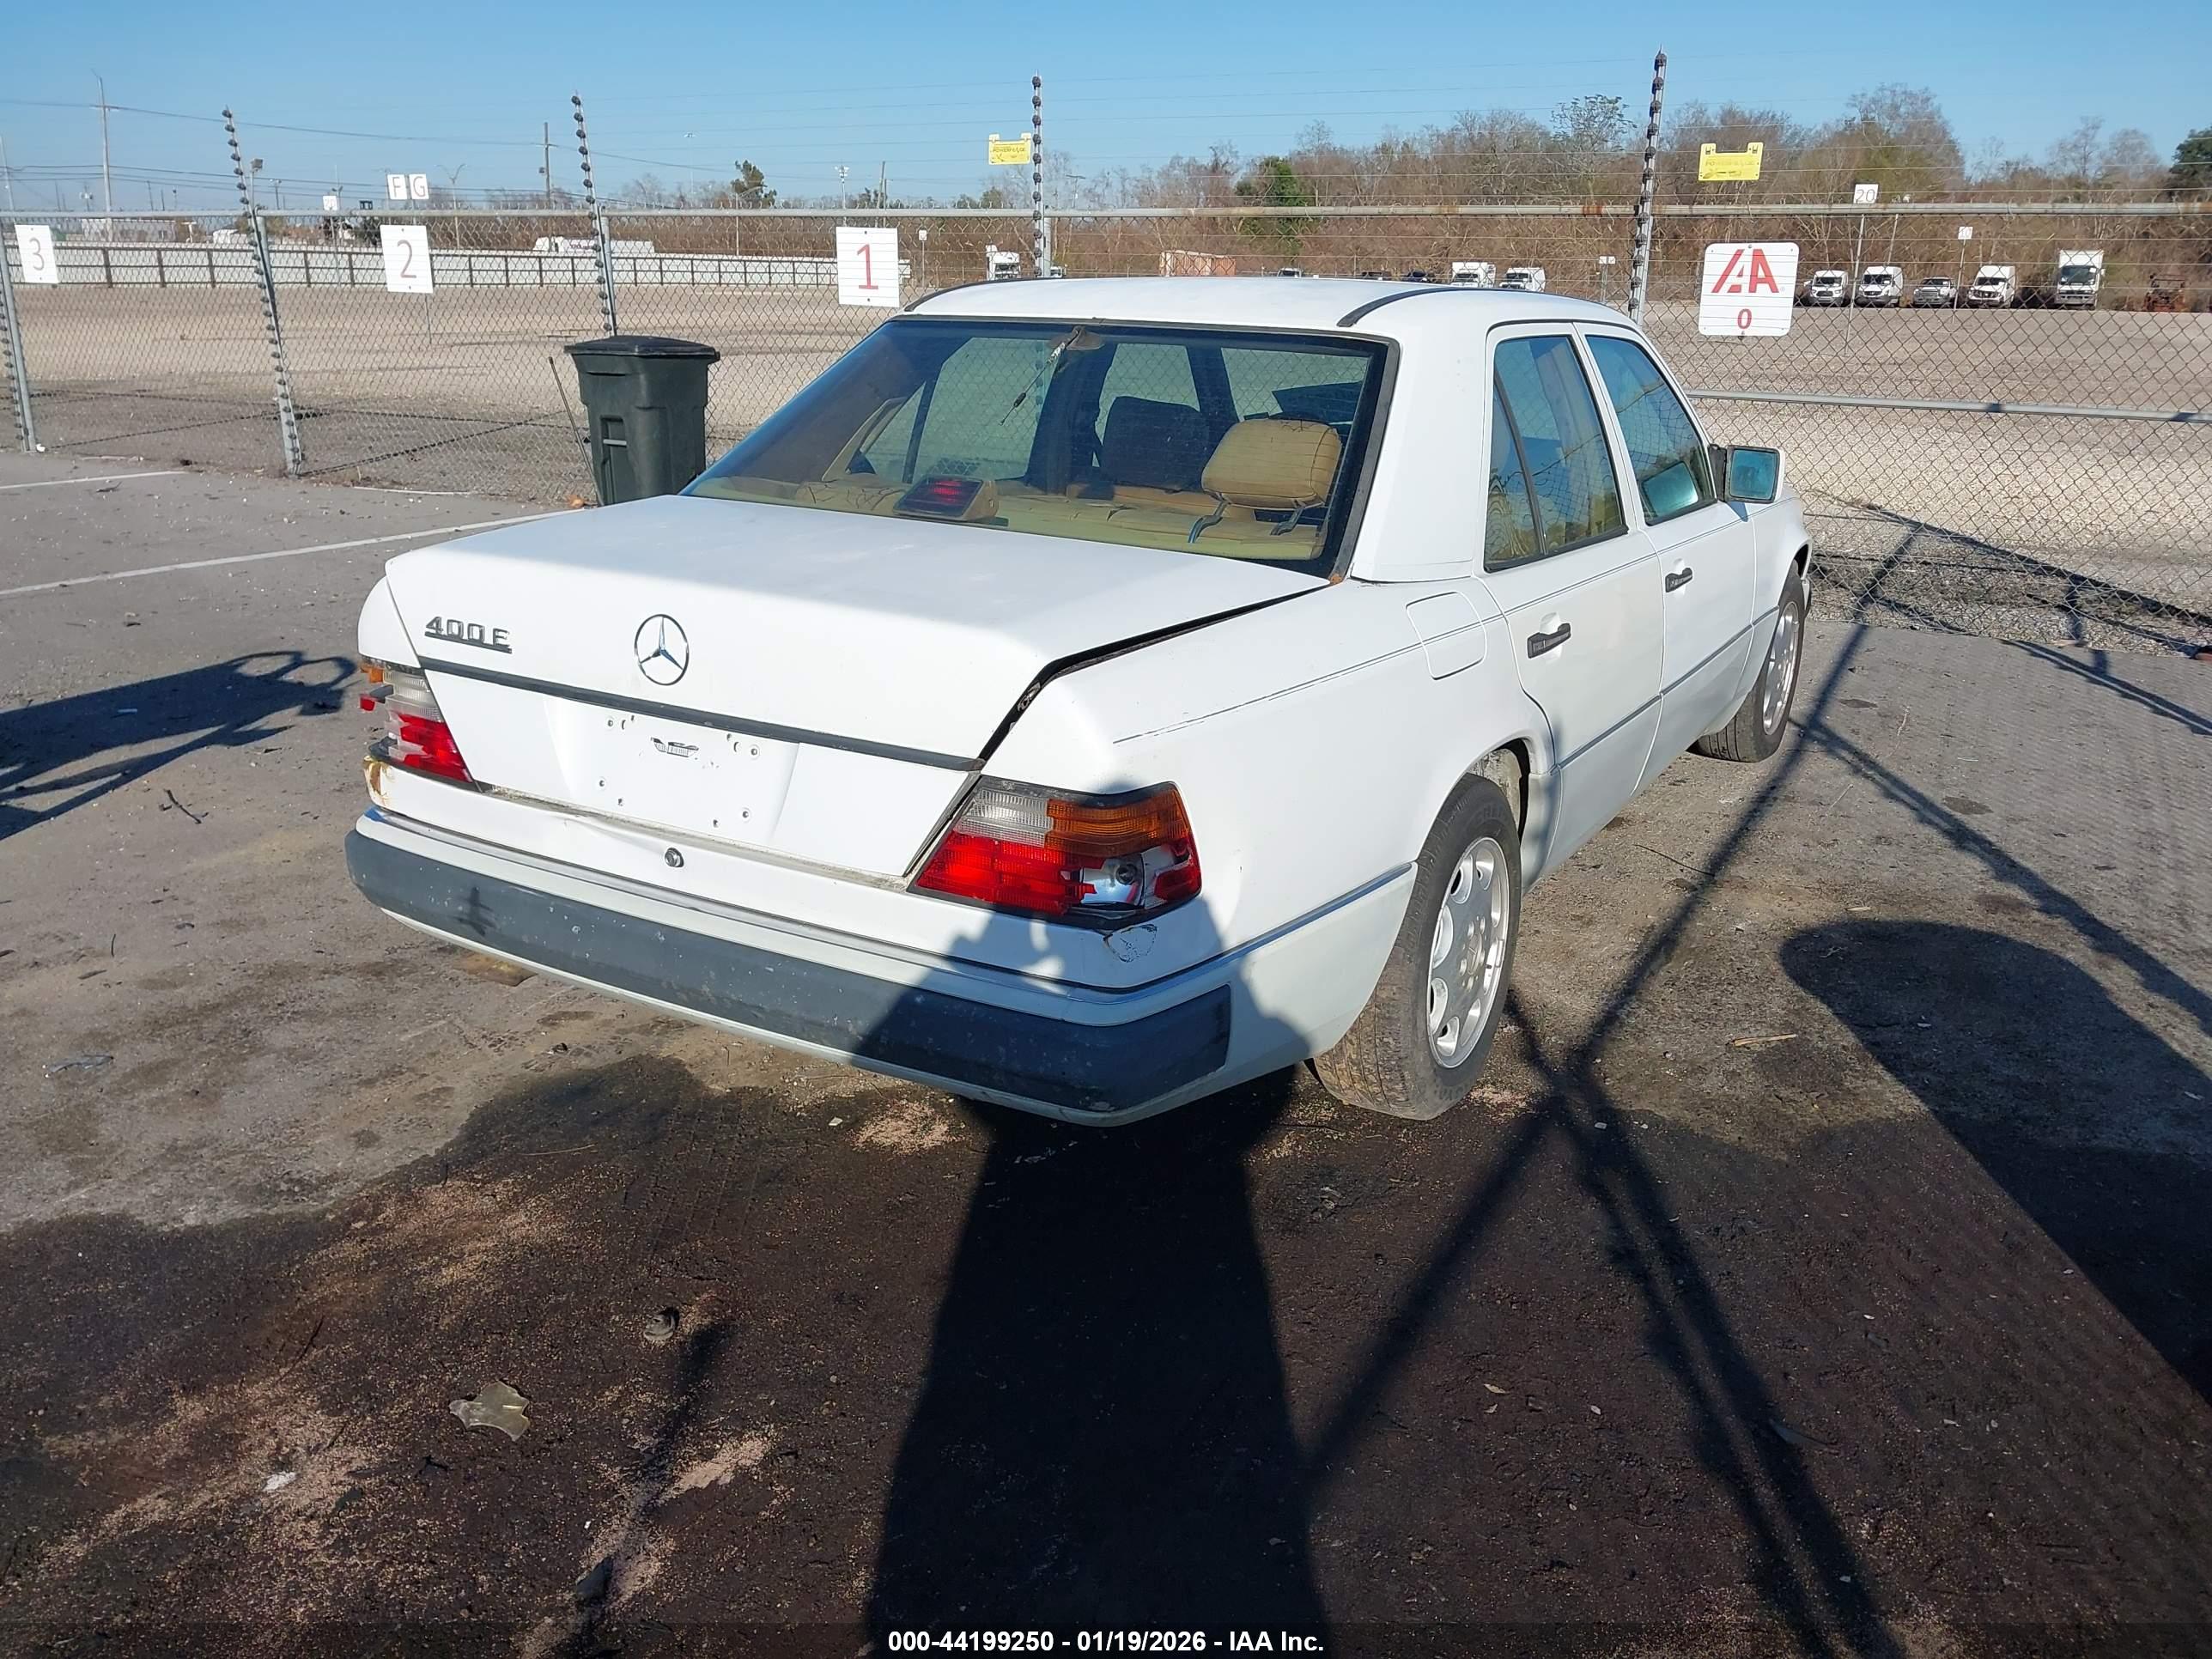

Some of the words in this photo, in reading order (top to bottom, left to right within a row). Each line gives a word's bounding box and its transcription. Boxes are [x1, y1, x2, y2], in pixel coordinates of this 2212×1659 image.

[392, 176, 401, 198] F
[413, 175, 427, 198] G
[1856, 188, 1876, 204] 20
[29, 237, 45, 270] 3
[397, 240, 417, 278] 2
[857, 244, 878, 290] 1
[1737, 308, 1753, 330] 0
